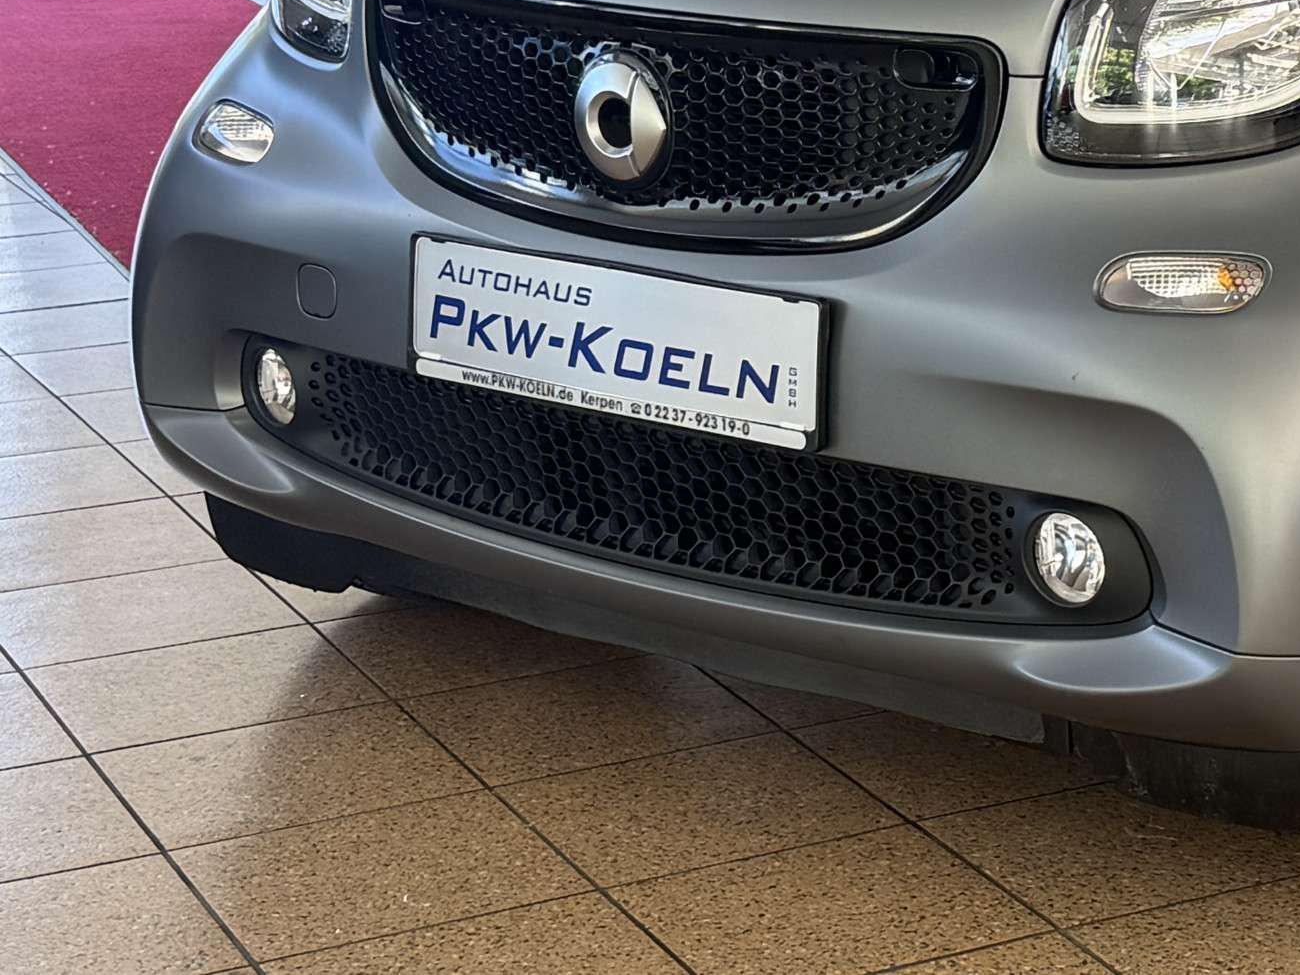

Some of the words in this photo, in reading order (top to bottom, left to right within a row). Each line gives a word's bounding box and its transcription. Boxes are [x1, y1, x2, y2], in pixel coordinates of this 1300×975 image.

[438, 259, 592, 306] AUTOHAUS
[430, 294, 780, 404] PKW-KOELN
[462, 370, 574, 401] www.PKW-KOELN.de
[580, 390, 623, 412] Kerpen
